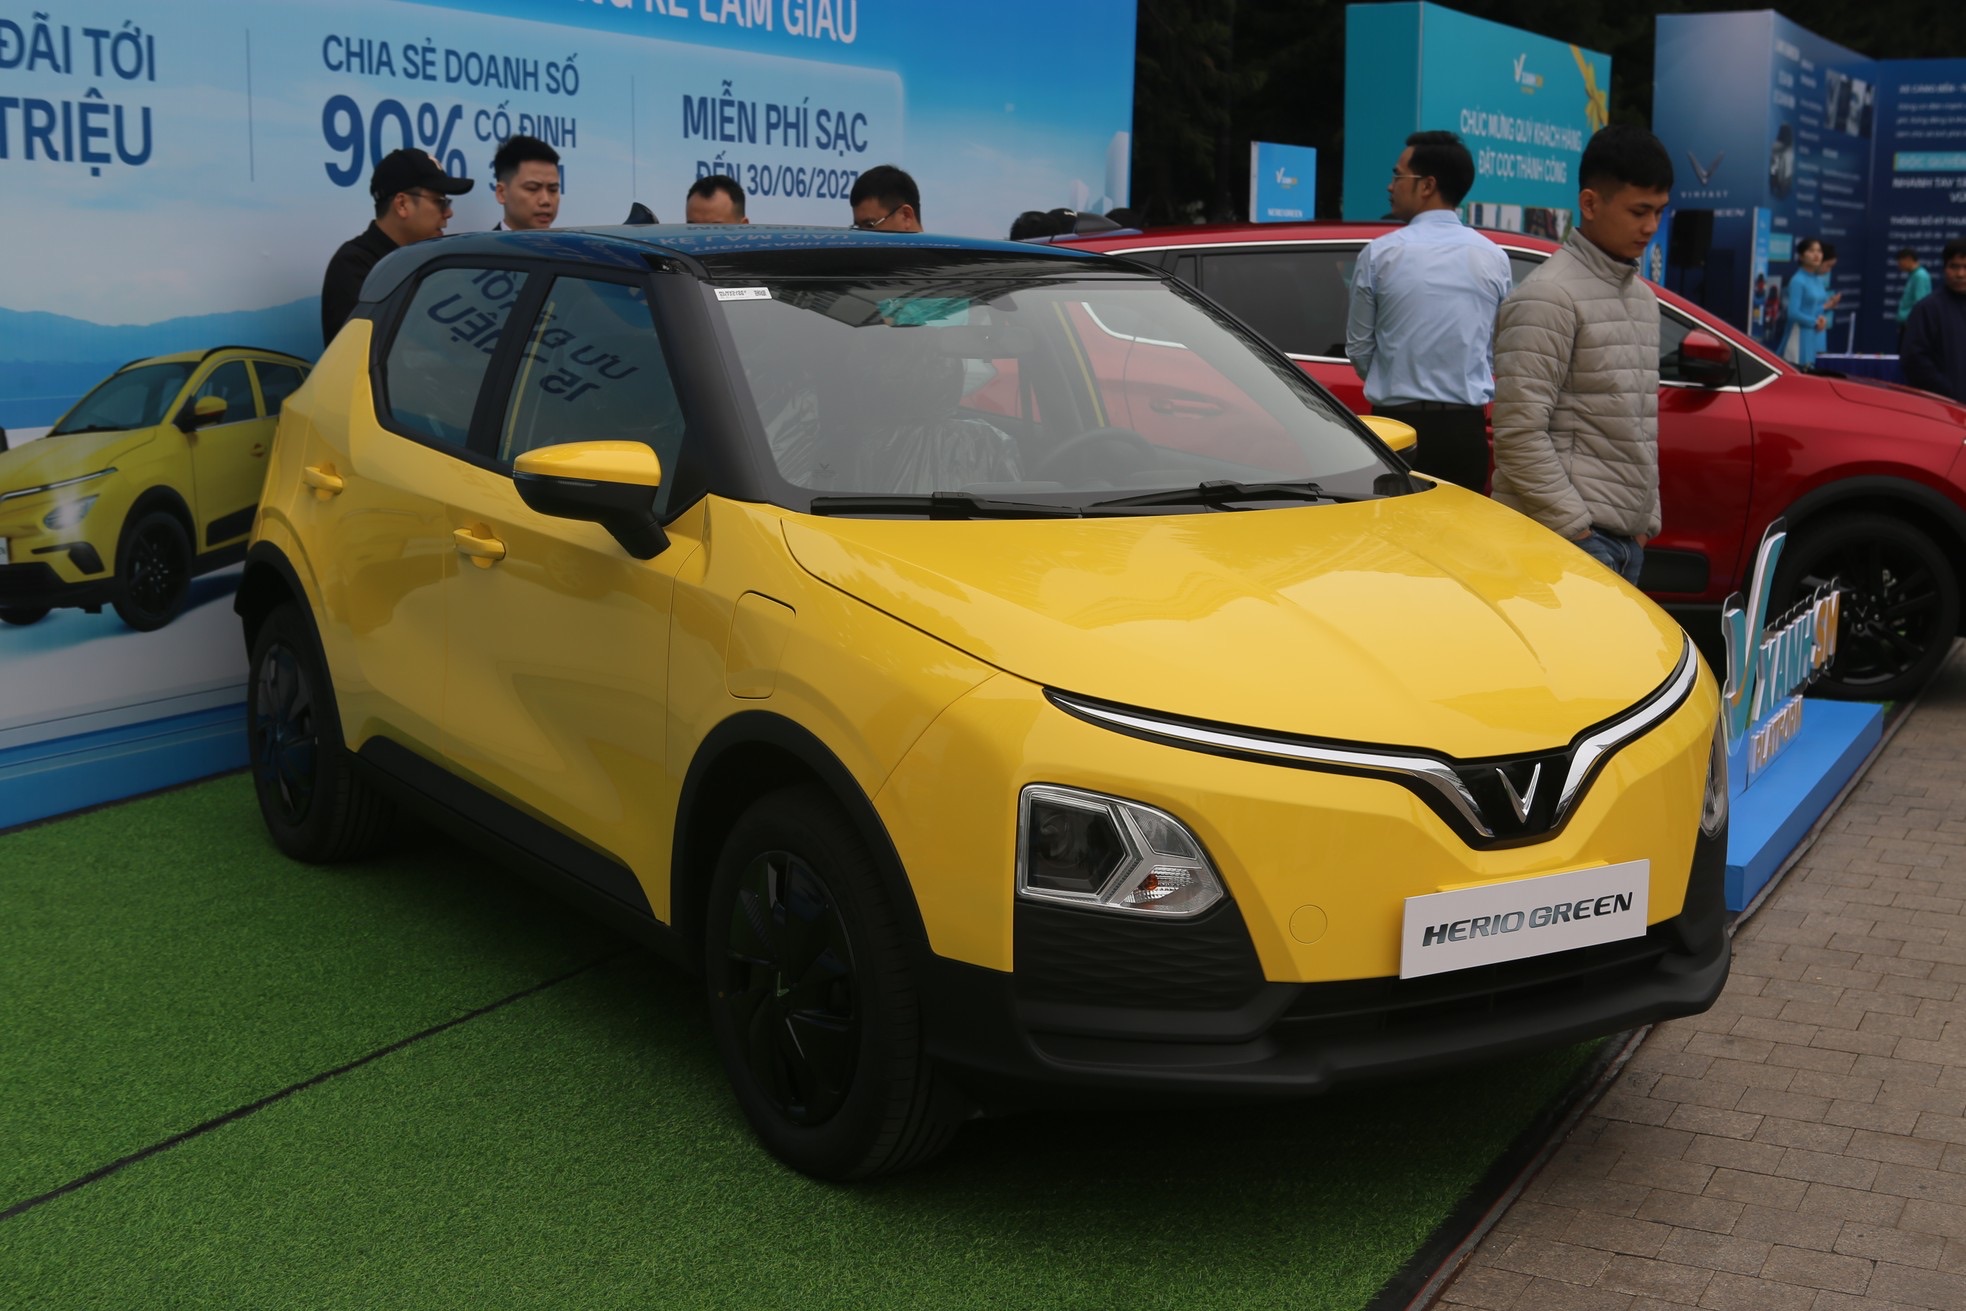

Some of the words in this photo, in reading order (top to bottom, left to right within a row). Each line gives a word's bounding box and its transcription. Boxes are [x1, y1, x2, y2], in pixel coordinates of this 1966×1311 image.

[0, 11, 73, 75] ĐÃI
[82, 19, 156, 82] TỚI
[322, 34, 396, 78] CHIA
[403, 37, 437, 82] SẺ
[445, 48, 539, 92] DOANH
[545, 52, 580, 96] SỐ
[322, 94, 467, 188] 90%
[474, 99, 511, 143] CỐ
[682, 79, 757, 144] MIỄN
[765, 96, 809, 148] PHÍ
[815, 108, 868, 157] SẠC
[1460, 104, 1487, 136] CHÚC
[1422, 911, 1525, 947] HERIO
[1529, 891, 1633, 929] GREEN
